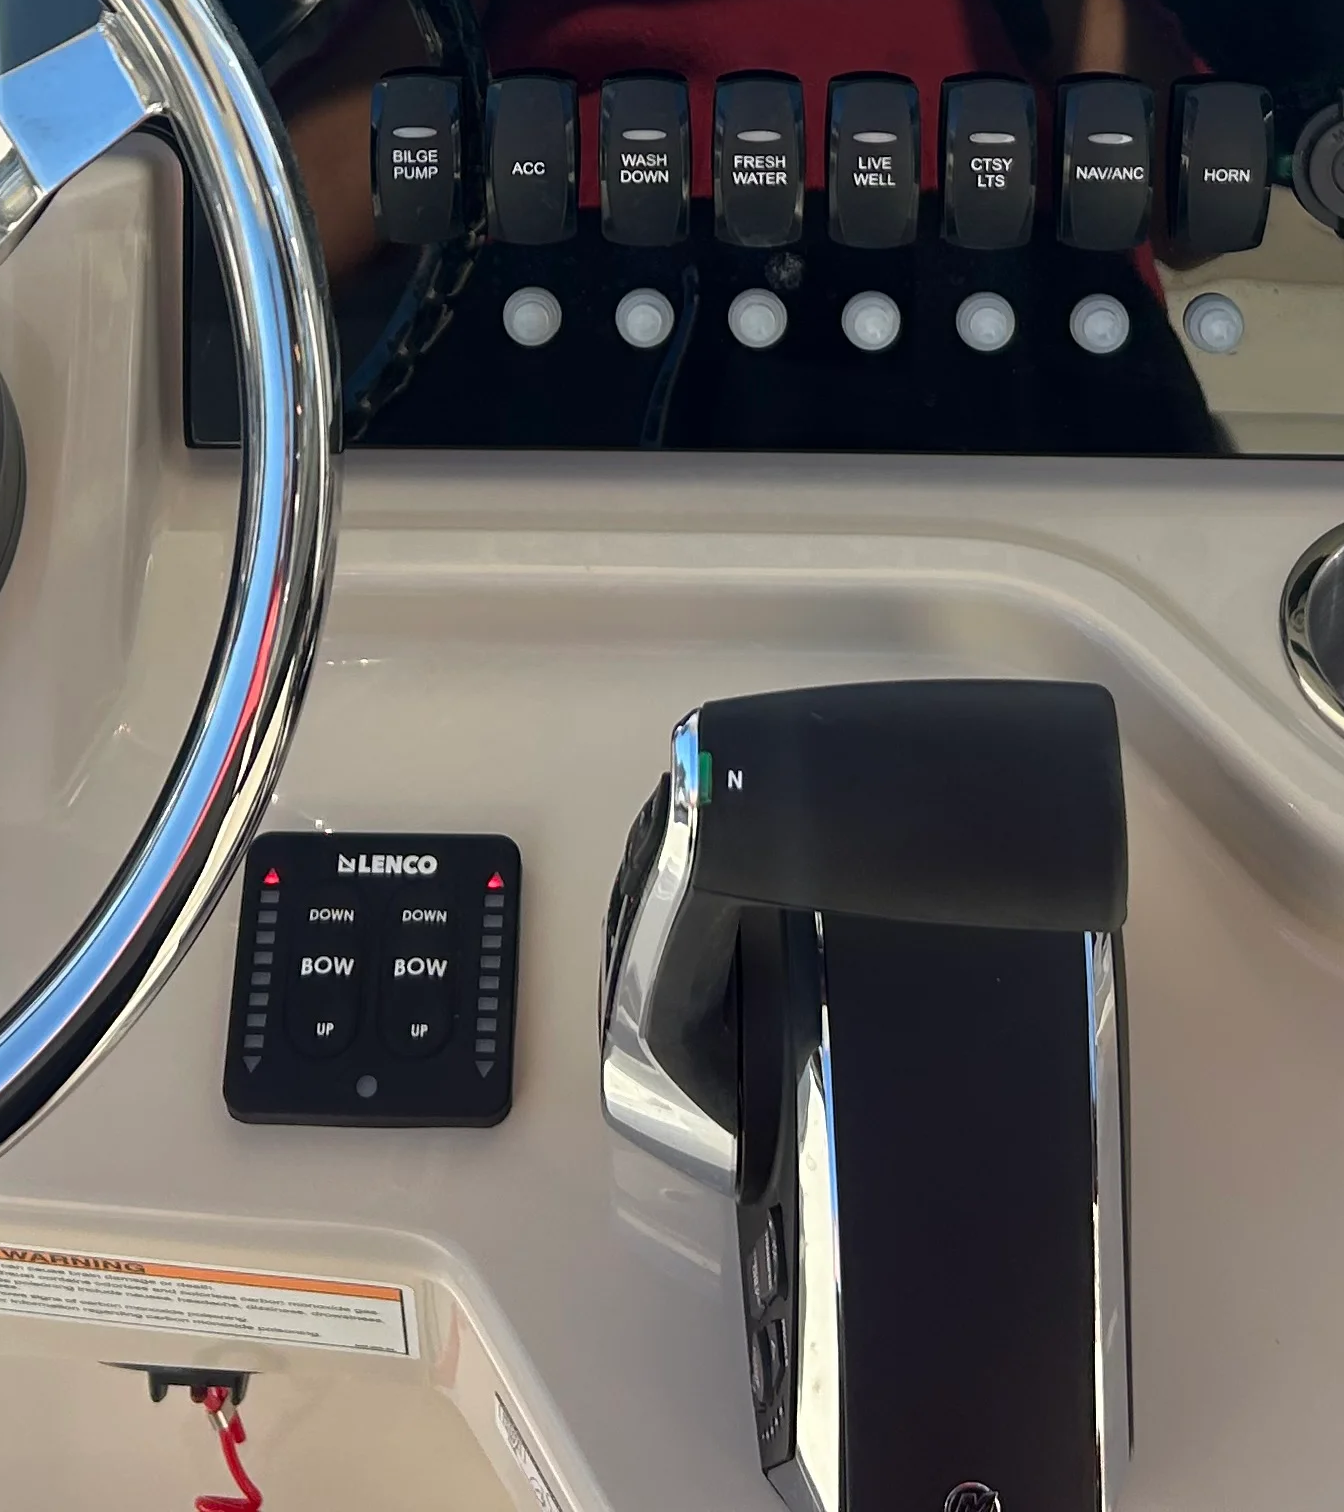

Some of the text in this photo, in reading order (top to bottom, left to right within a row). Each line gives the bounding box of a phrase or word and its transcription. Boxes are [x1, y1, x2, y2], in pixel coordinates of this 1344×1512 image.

[392, 149, 438, 163] BILGE
[620, 153, 668, 167] WASH
[734, 155, 786, 169] FRESH
[858, 156, 892, 170] LIVE
[511, 161, 546, 175] ACC
[971, 158, 1013, 172] CTSY
[393, 166, 439, 180] PUMP
[620, 169, 669, 183] DOWN
[732, 171, 787, 185] WATER
[853, 173, 896, 186] WELL
[1076, 166, 1144, 180] NAV/ANC
[1204, 169, 1251, 183] HORN
[977, 175, 1005, 188] LTS
[728, 769, 743, 789] N
[358, 854, 438, 875] LENCO
[309, 908, 354, 922] DOWN
[402, 909, 447, 923] DOWN
[300, 956, 355, 976] BOW
[394, 957, 448, 978] BOW
[316, 1022, 335, 1036] UP
[410, 1023, 429, 1037] UP
[0, 1248, 146, 1274] WARNING
